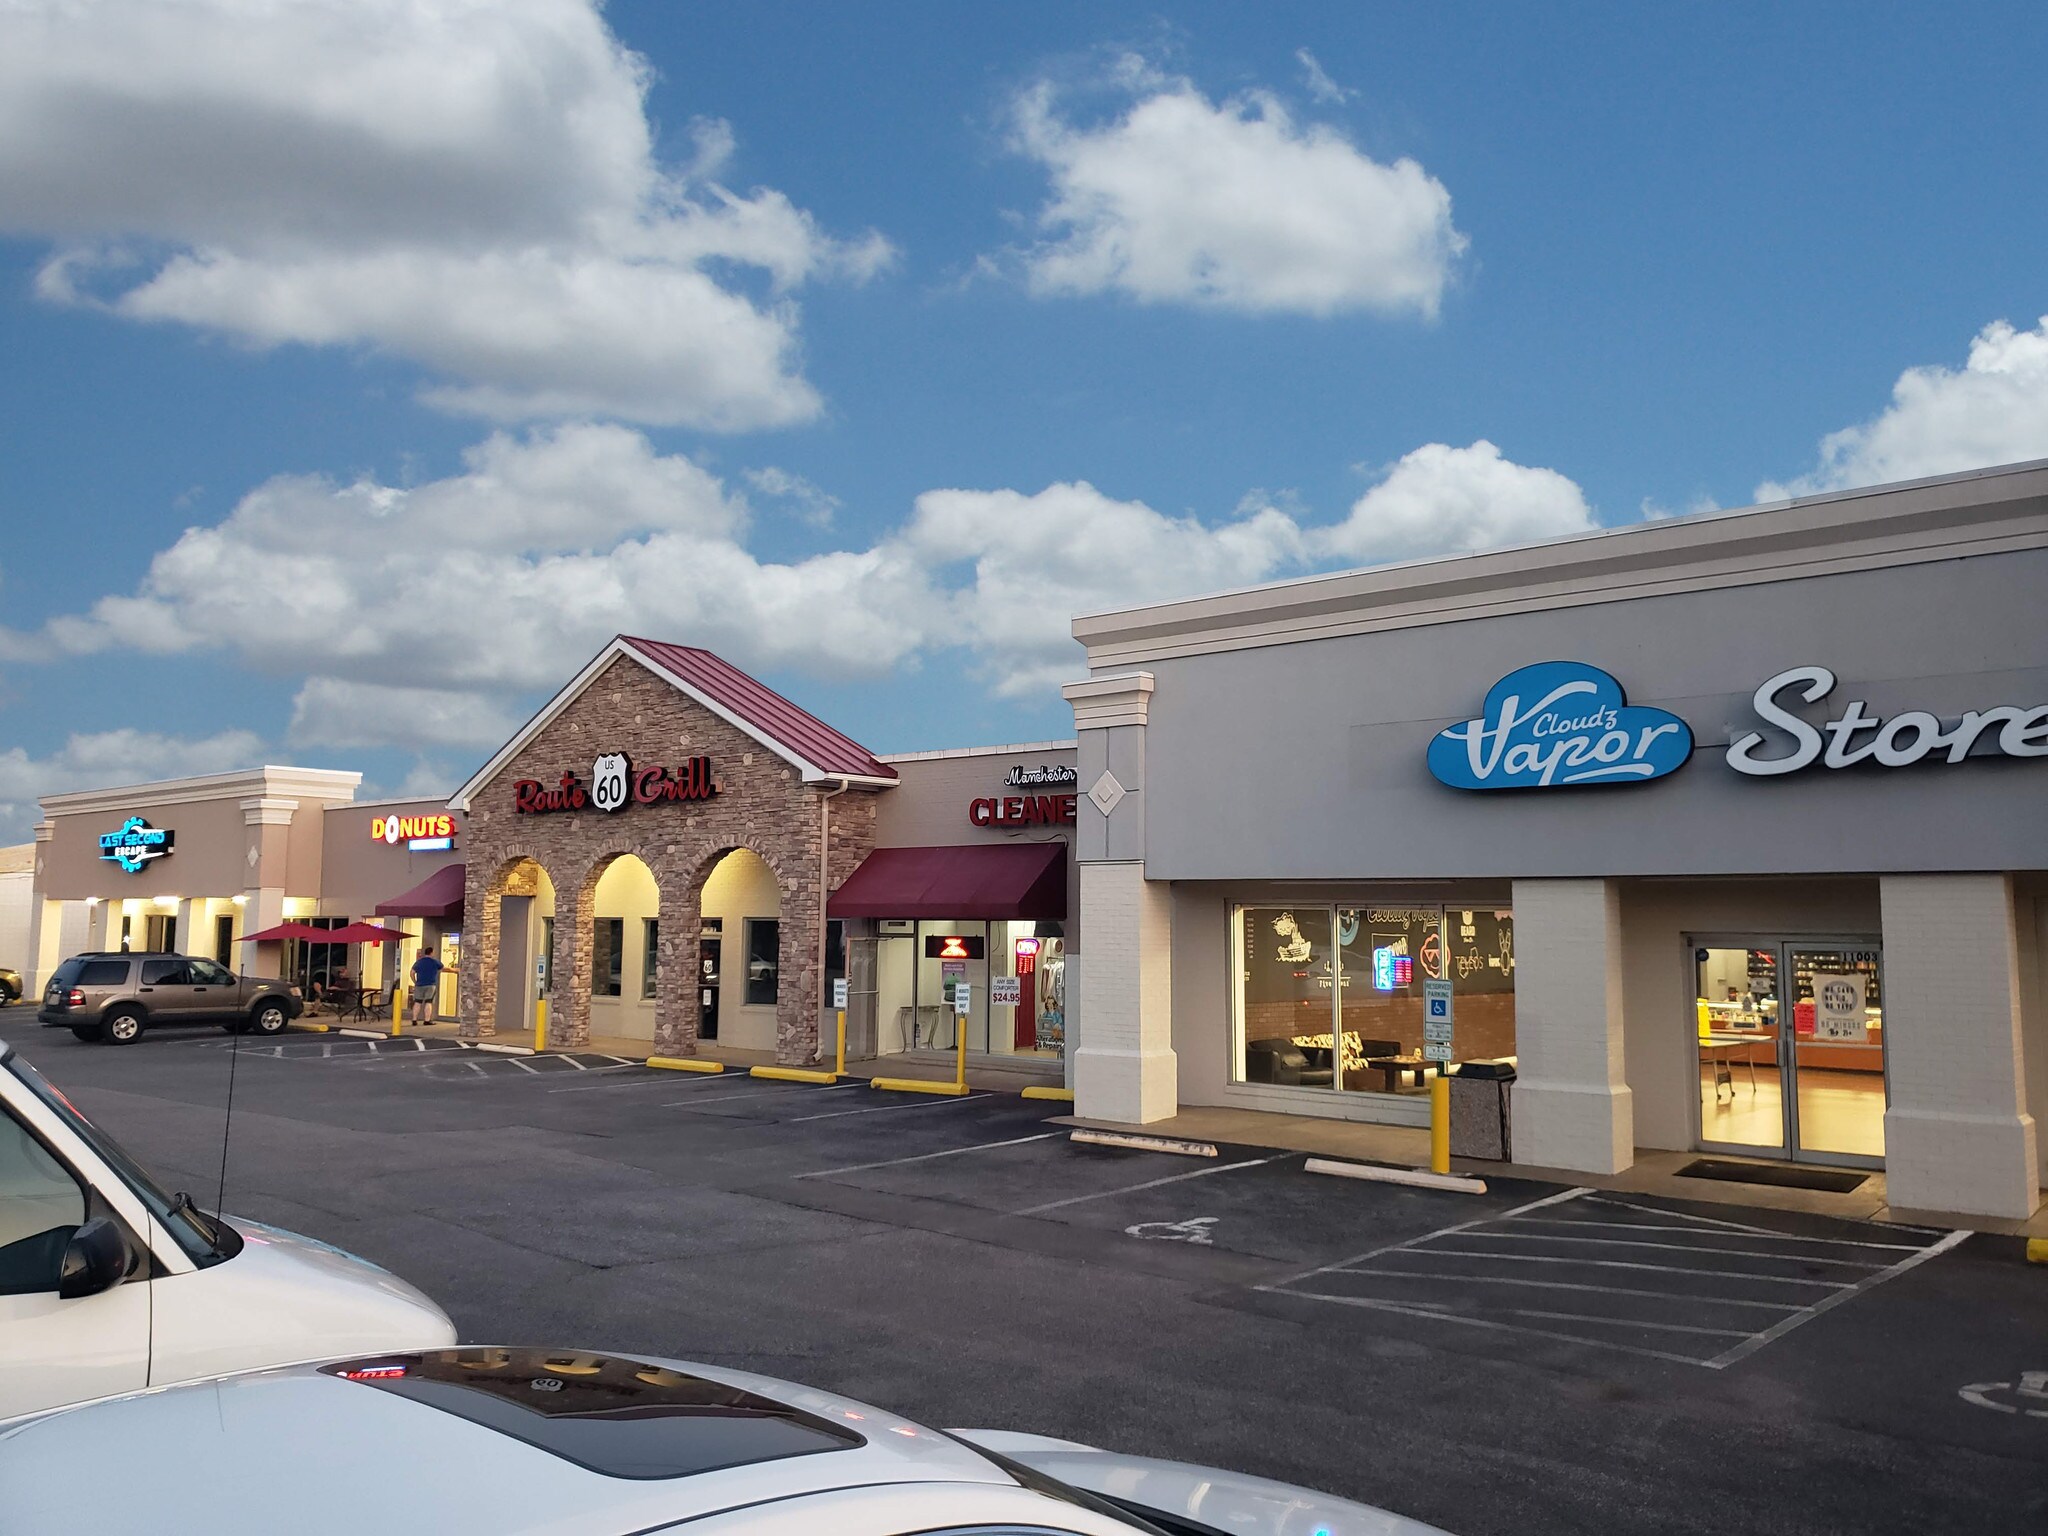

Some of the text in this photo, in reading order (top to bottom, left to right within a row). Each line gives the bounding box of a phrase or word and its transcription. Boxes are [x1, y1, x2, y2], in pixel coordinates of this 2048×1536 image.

[1533, 705, 1618, 737] Cloudz
[1726, 666, 2048, 776] Store
[1441, 681, 1679, 786] Vapor
[604, 760, 615, 770] US
[513, 756, 713, 813] Route 60 Grill
[1004, 766, 1077, 786] Manchester
[370, 814, 453, 844] DONUTS
[99, 832, 165, 848] LAST SECOND
[115, 846, 147, 857] ESCAPE
[1843, 952, 1878, 962] 11003
[1426, 982, 1451, 990] RESERVED
[993, 993, 1020, 1003] $24.95
